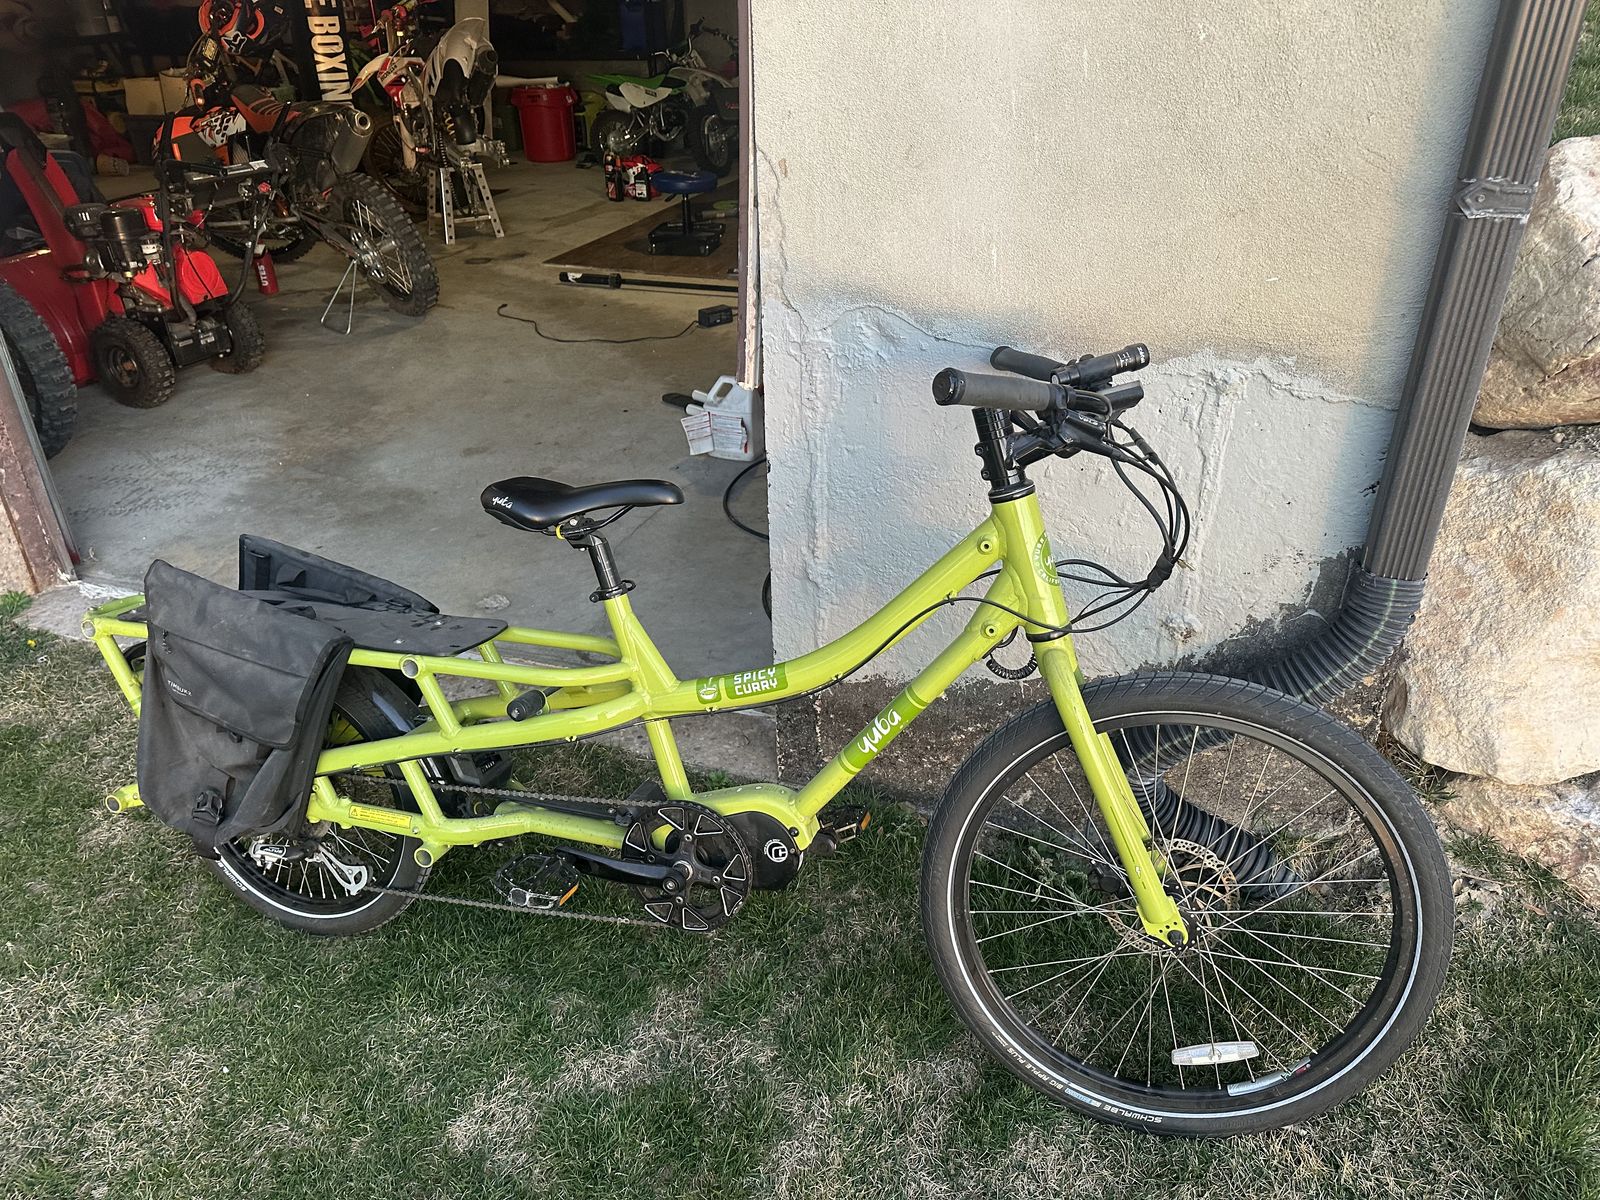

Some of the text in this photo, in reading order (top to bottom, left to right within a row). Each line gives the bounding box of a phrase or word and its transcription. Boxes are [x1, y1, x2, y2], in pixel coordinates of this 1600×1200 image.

[307, 16, 353, 101] BOXIN
[258, 264, 269, 287] UTES
[734, 667, 776, 685] SPICY
[735, 678, 778, 696] CURRY
[857, 708, 902, 753] yuba
[1006, 1047, 1163, 1124] SCHWALBE BIG APPLE PLUS
